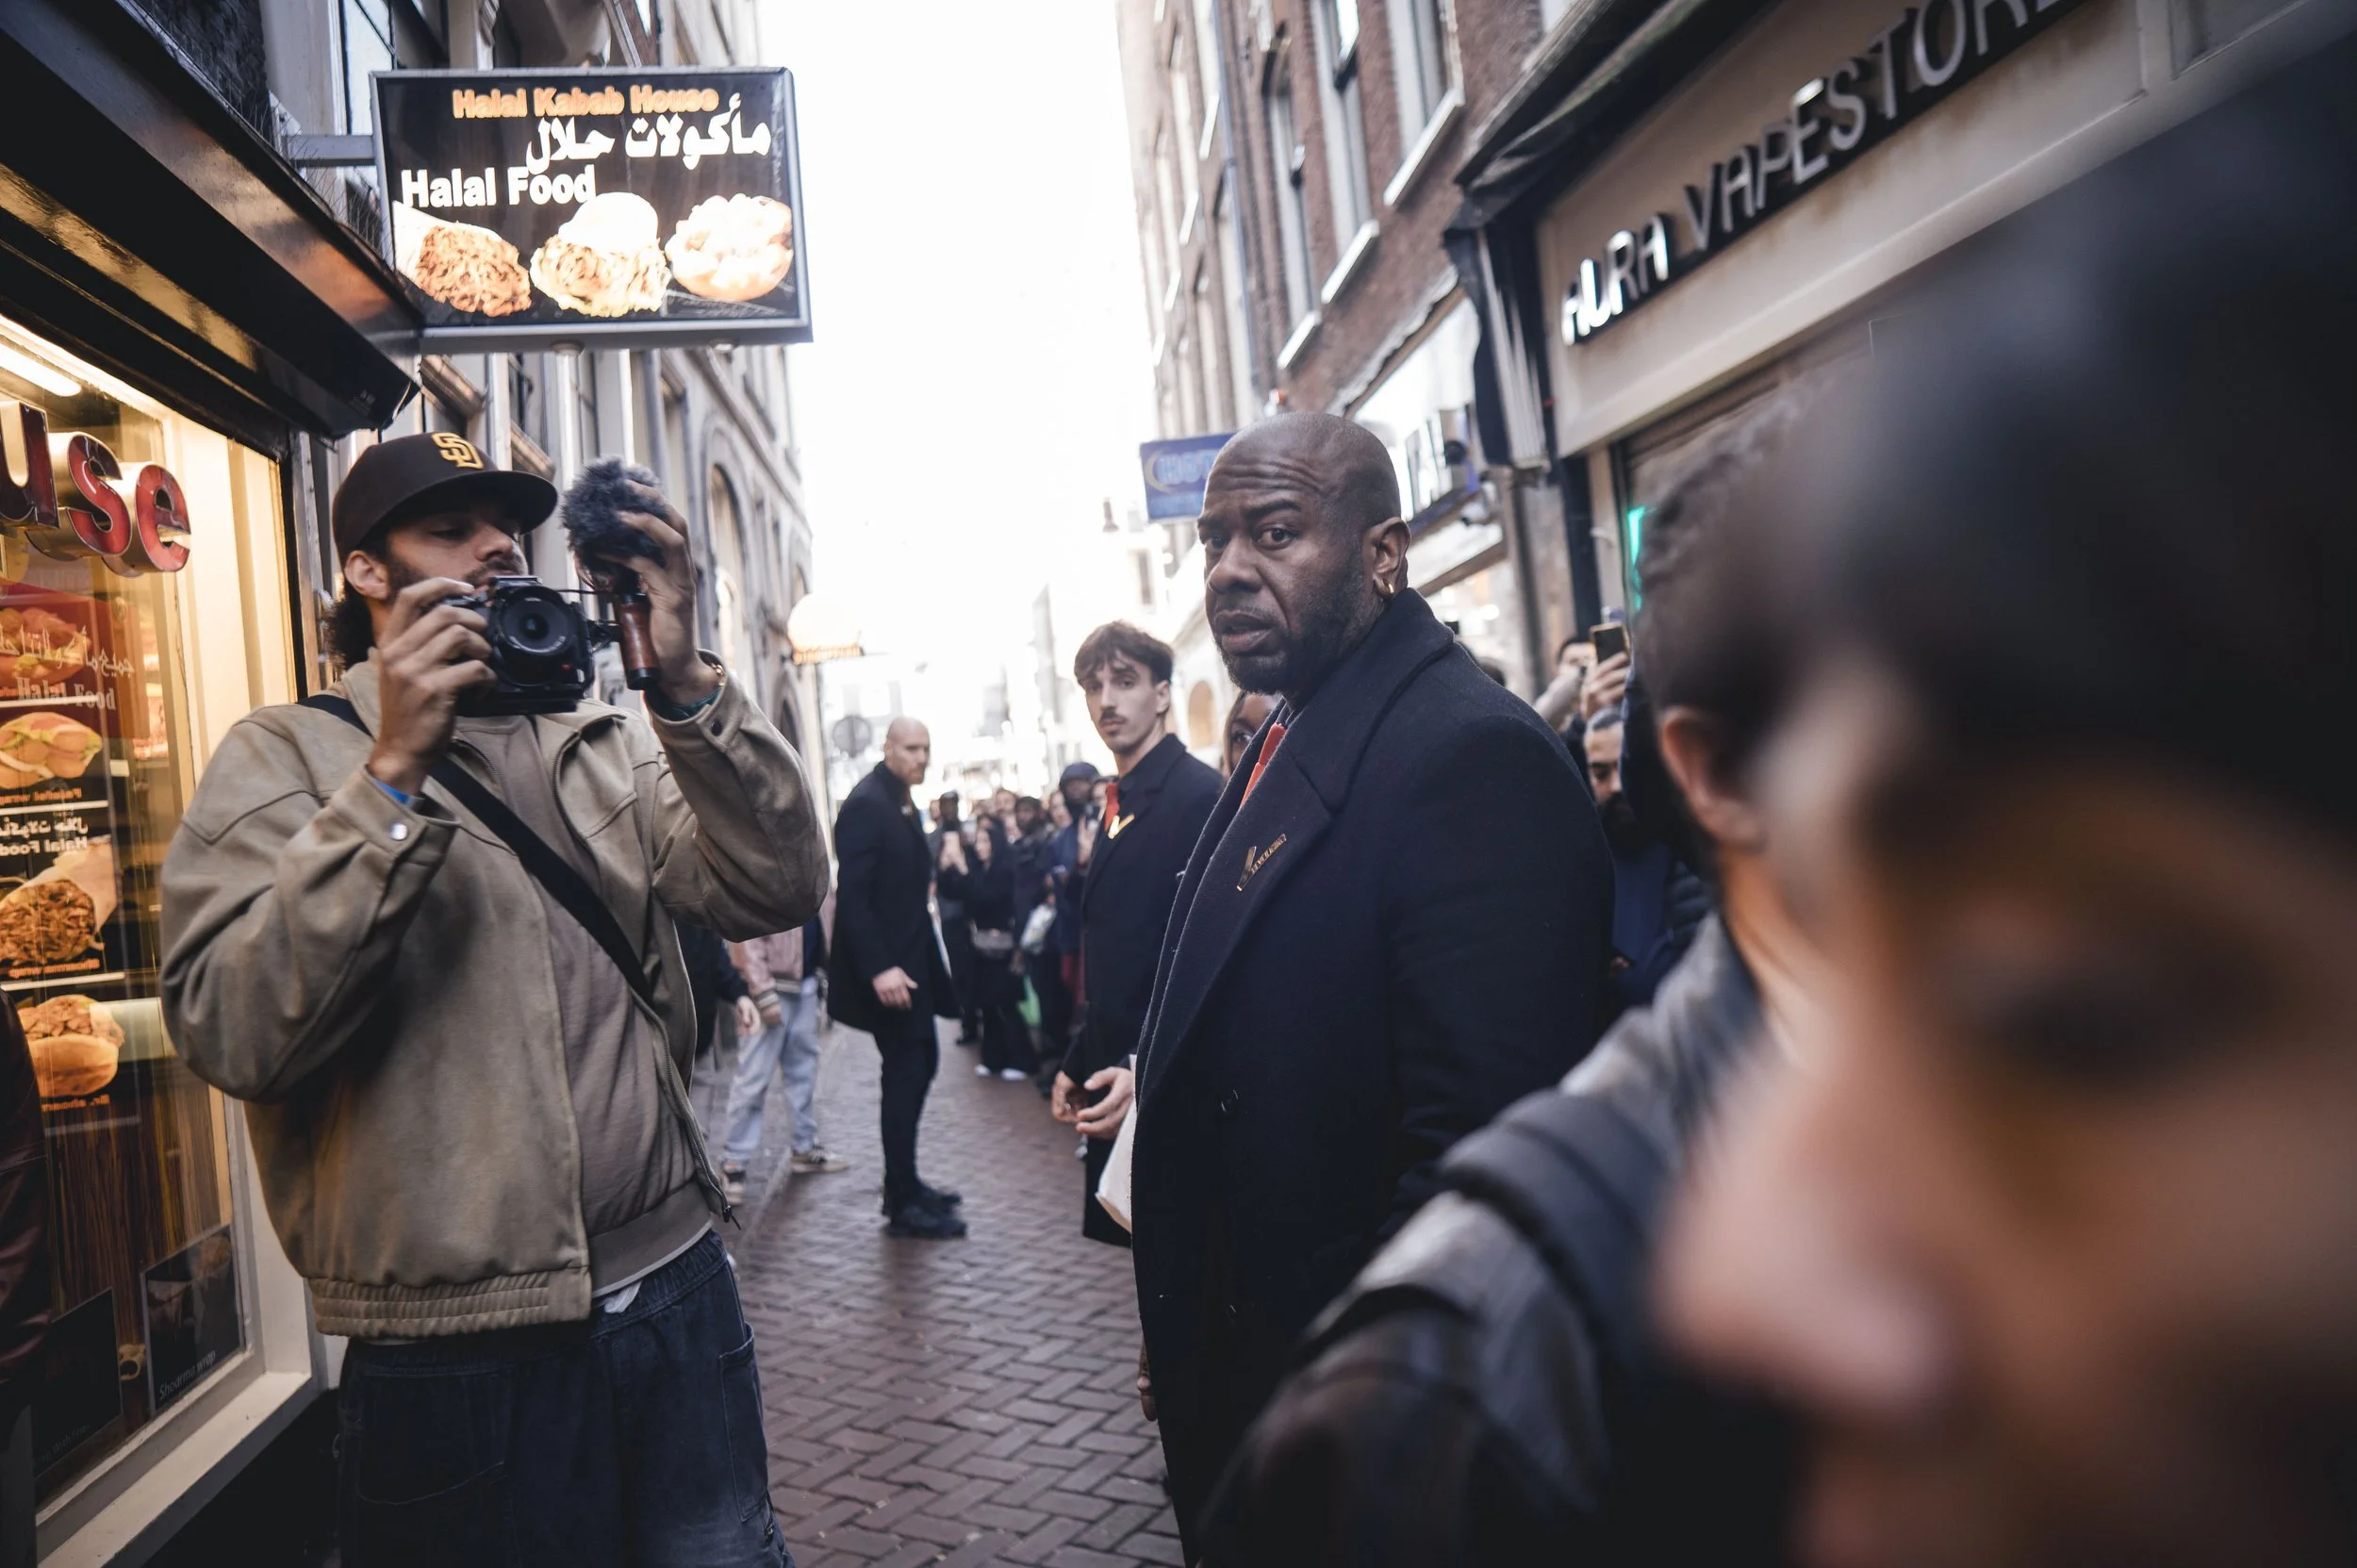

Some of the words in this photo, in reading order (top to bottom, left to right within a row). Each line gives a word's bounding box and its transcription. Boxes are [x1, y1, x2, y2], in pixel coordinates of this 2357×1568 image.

[453, 88, 528, 119] Halal
[534, 86, 625, 116] Kabab
[630, 84, 719, 113] House
[526, 116, 616, 175] حلال
[625, 92, 771, 170] مأكولات
[401, 169, 497, 208] Halal
[507, 164, 597, 206] Food
[1561, 213, 1669, 346] AURA
[1683, 0, 2061, 251] VAPESTOR
[16, 676, 68, 705] Halal
[74, 683, 116, 711] Food
[158, 1362, 196, 1400] Shoarma
[196, 1349, 217, 1374] wrap
